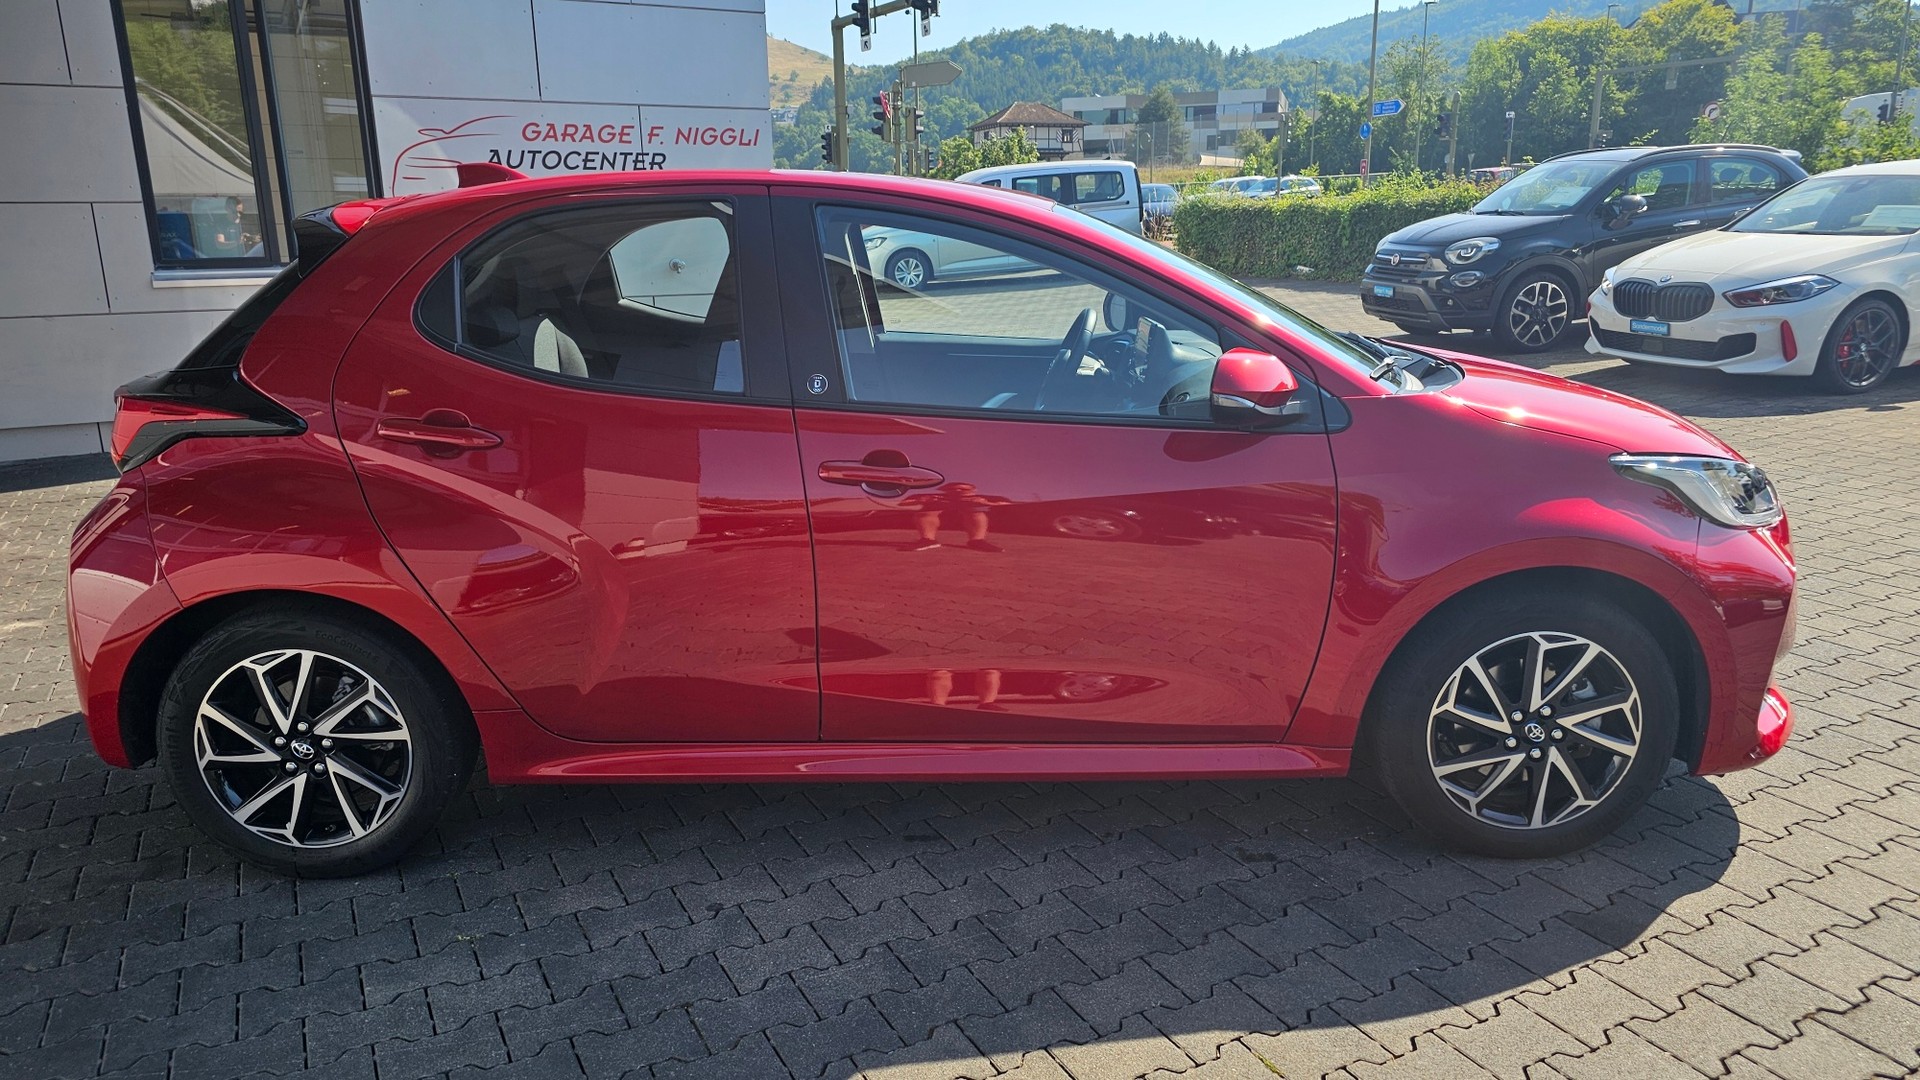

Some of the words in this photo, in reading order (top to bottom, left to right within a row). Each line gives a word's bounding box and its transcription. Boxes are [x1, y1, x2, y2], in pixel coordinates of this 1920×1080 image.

[522, 122, 634, 144] GARAGE
[647, 126, 665, 146] F.
[675, 127, 760, 147] NIGGLI
[488, 149, 667, 172] AUTOCENTER
